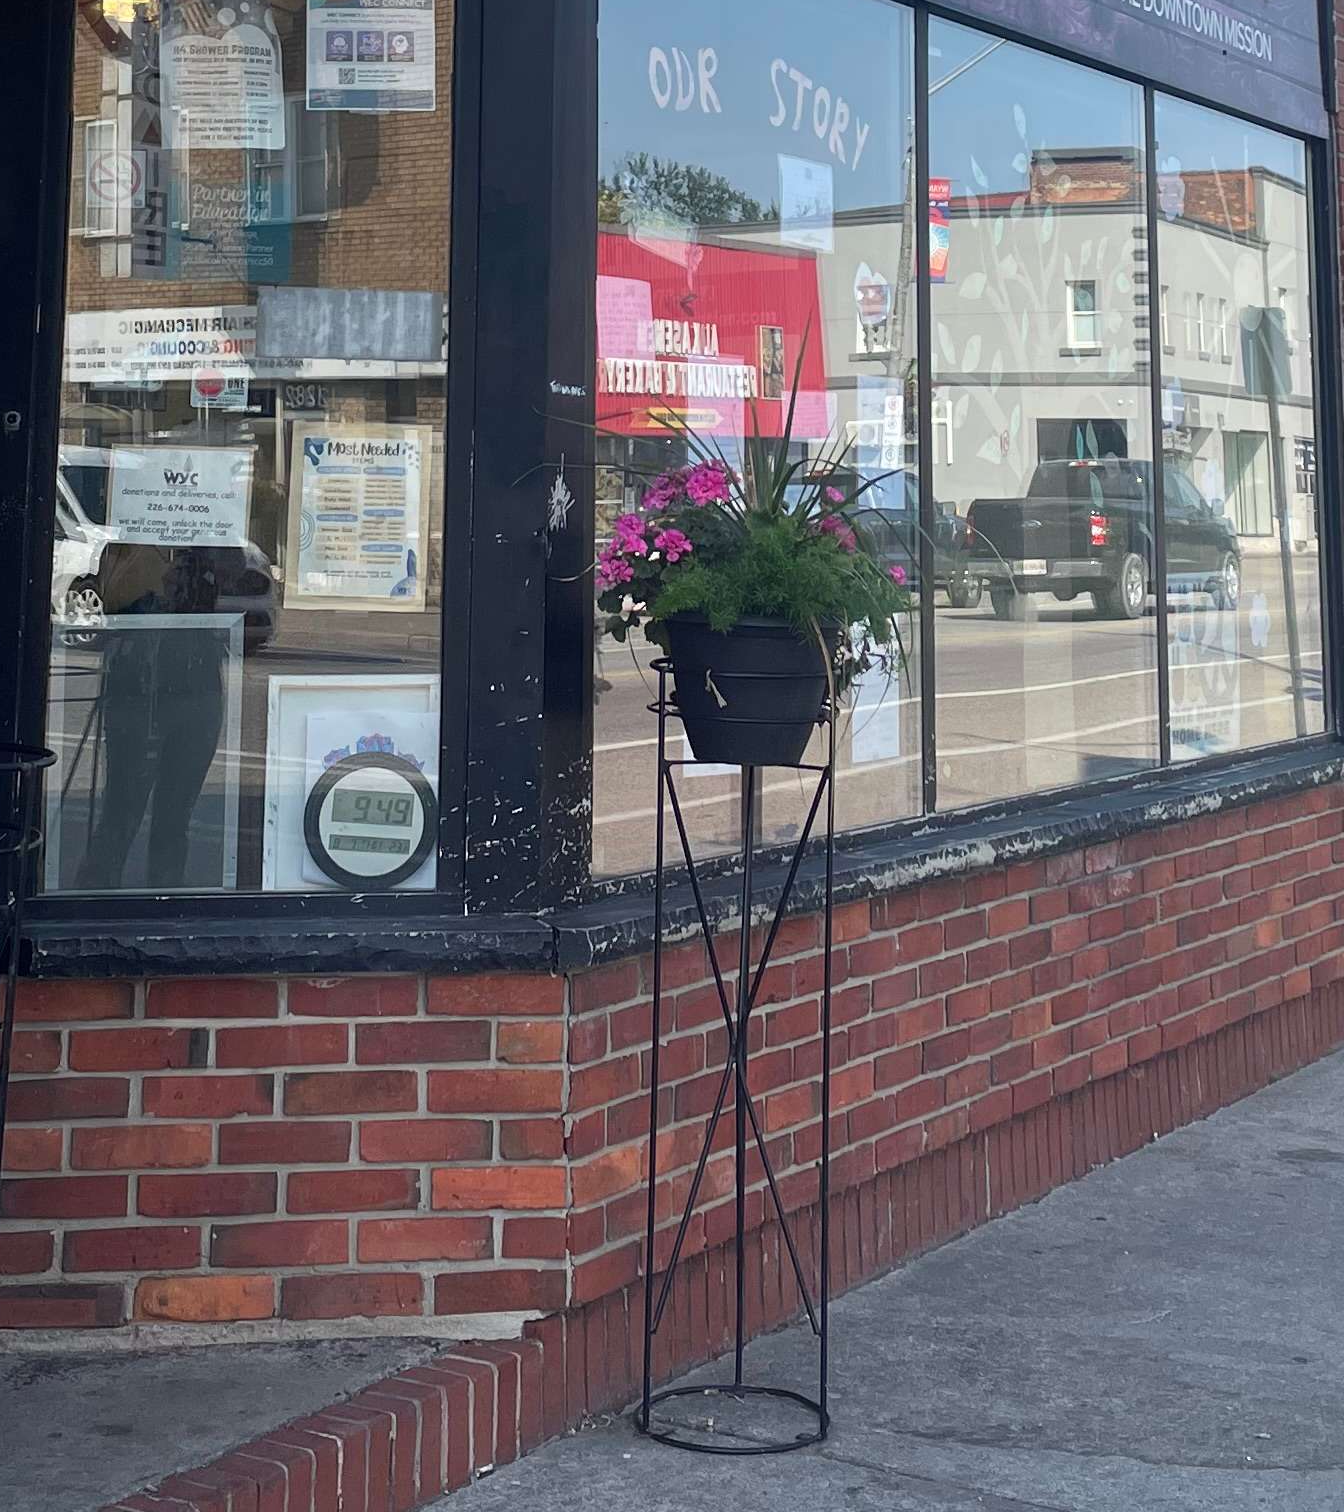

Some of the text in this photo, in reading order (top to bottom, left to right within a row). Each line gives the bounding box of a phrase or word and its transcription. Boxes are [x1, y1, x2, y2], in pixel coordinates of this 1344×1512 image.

[1225, 17, 1272, 62] MISSION
[648, 46, 870, 172] OUR STORY
[328, 441, 400, 457] Most Needed
[121, 488, 160, 497] donations
[161, 489, 176, 497] and
